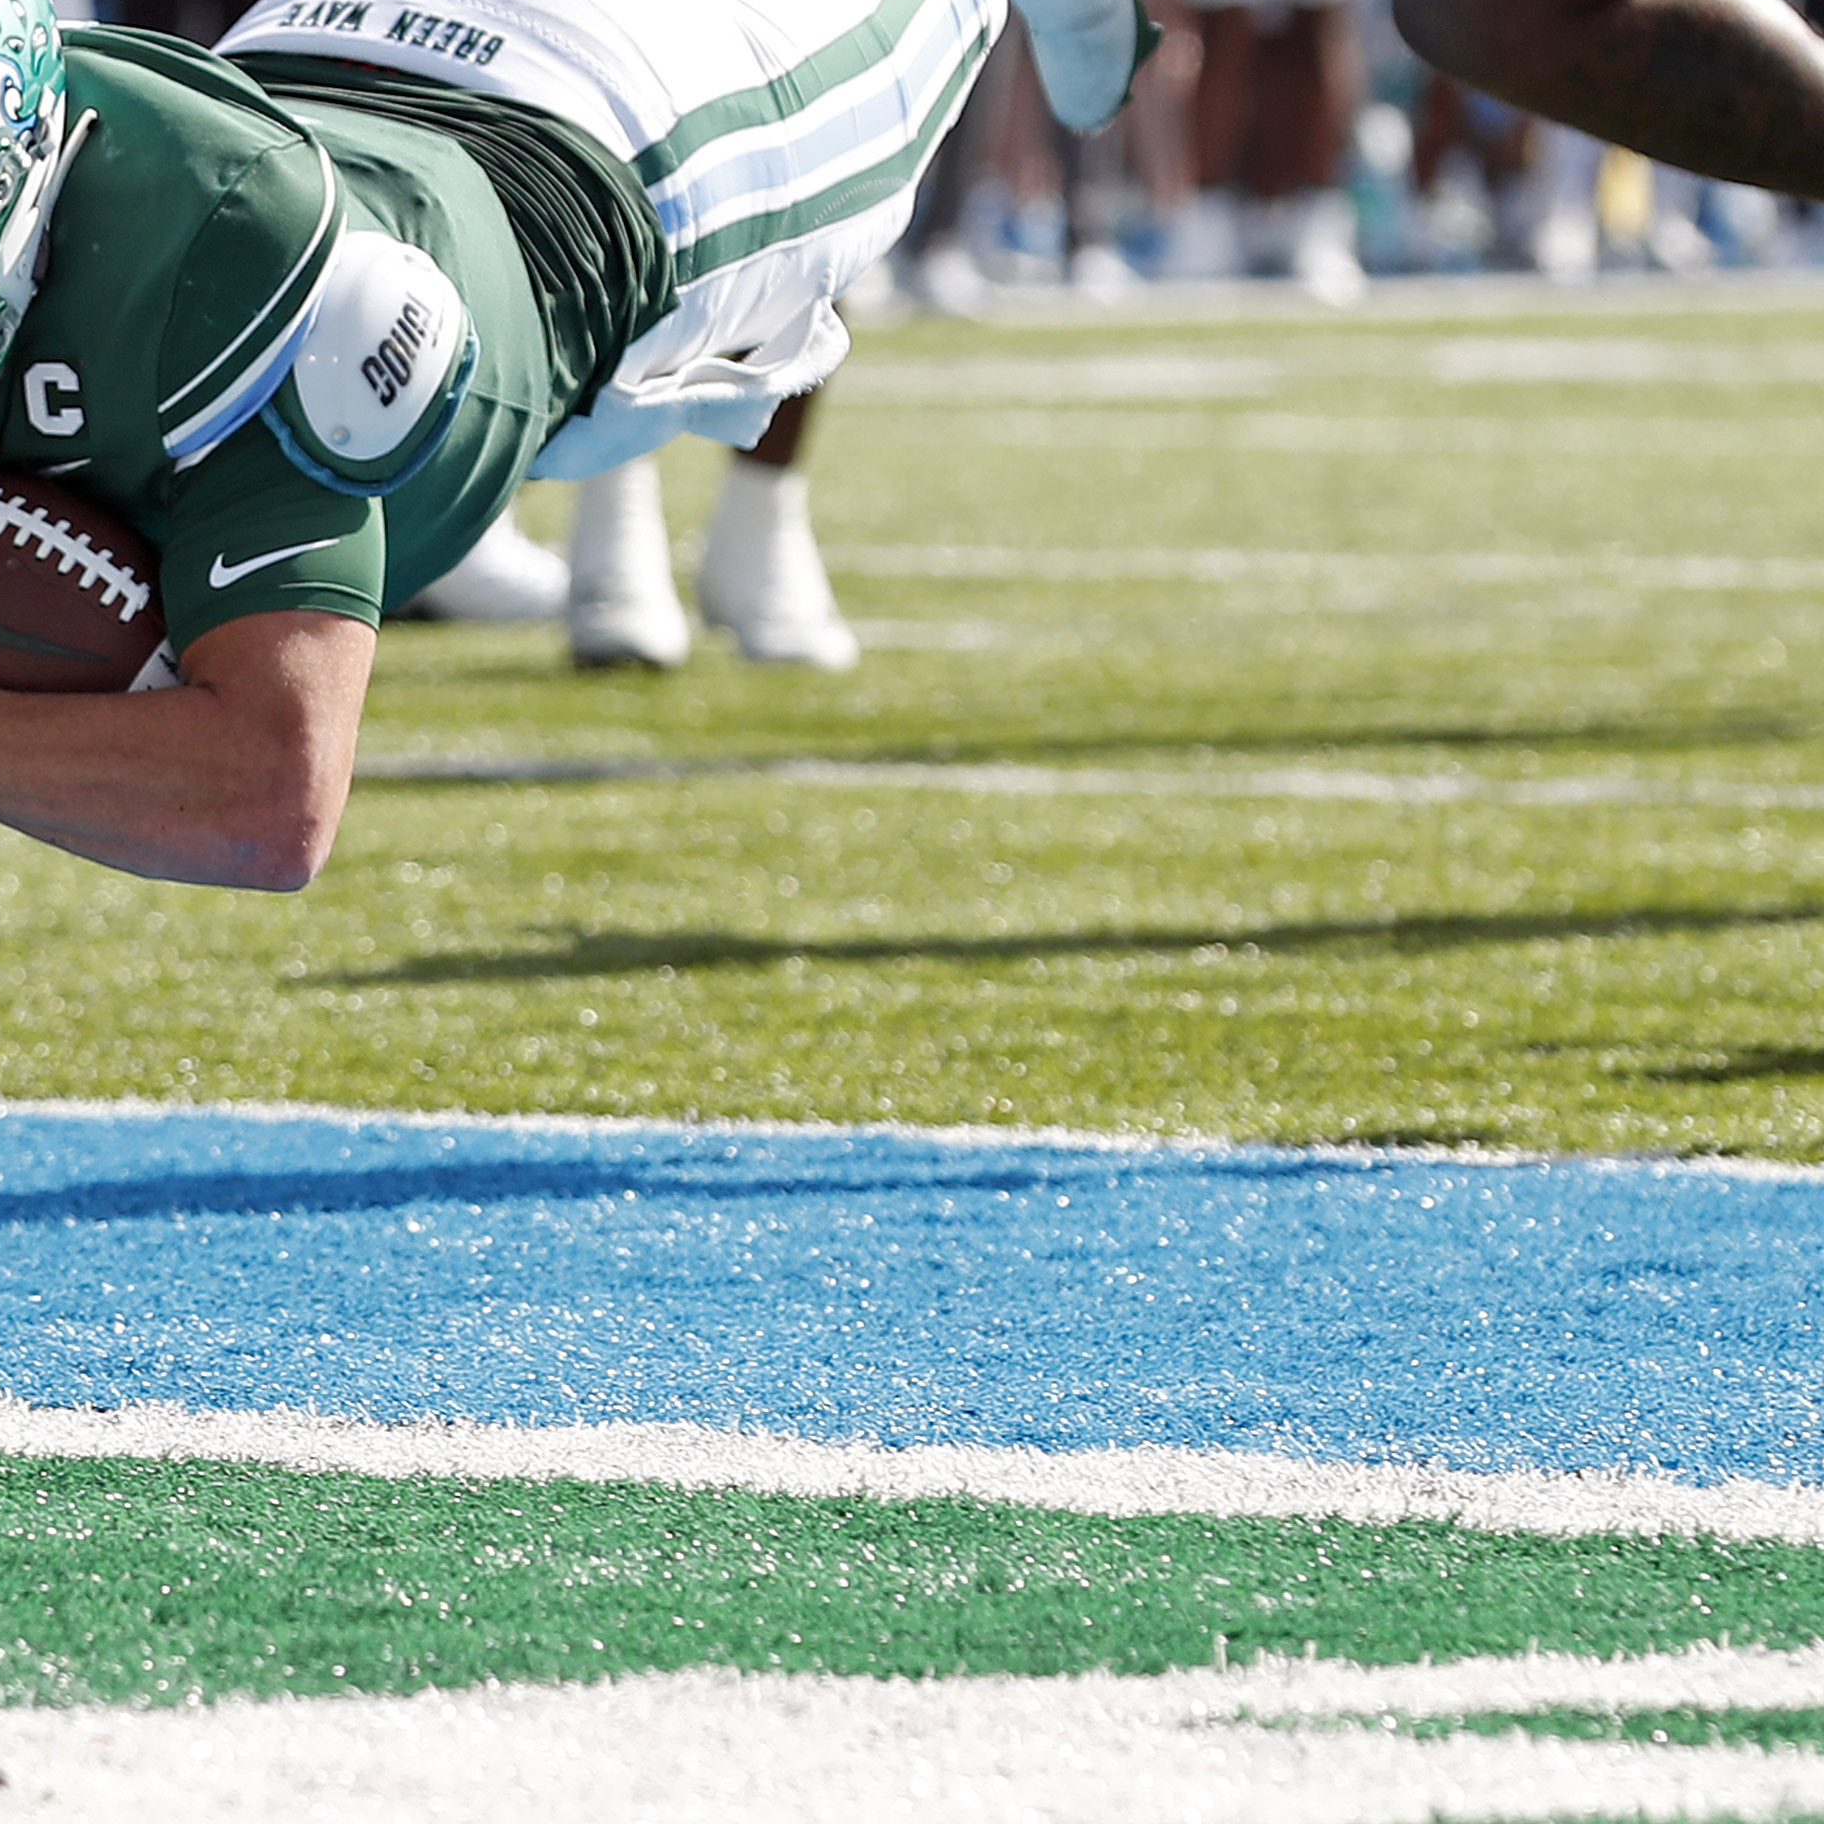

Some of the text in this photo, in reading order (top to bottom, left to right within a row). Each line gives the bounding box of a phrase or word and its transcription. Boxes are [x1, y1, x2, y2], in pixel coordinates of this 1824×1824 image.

[279, 0, 506, 66] GREEN WAVE
[22, 362, 85, 437] C
